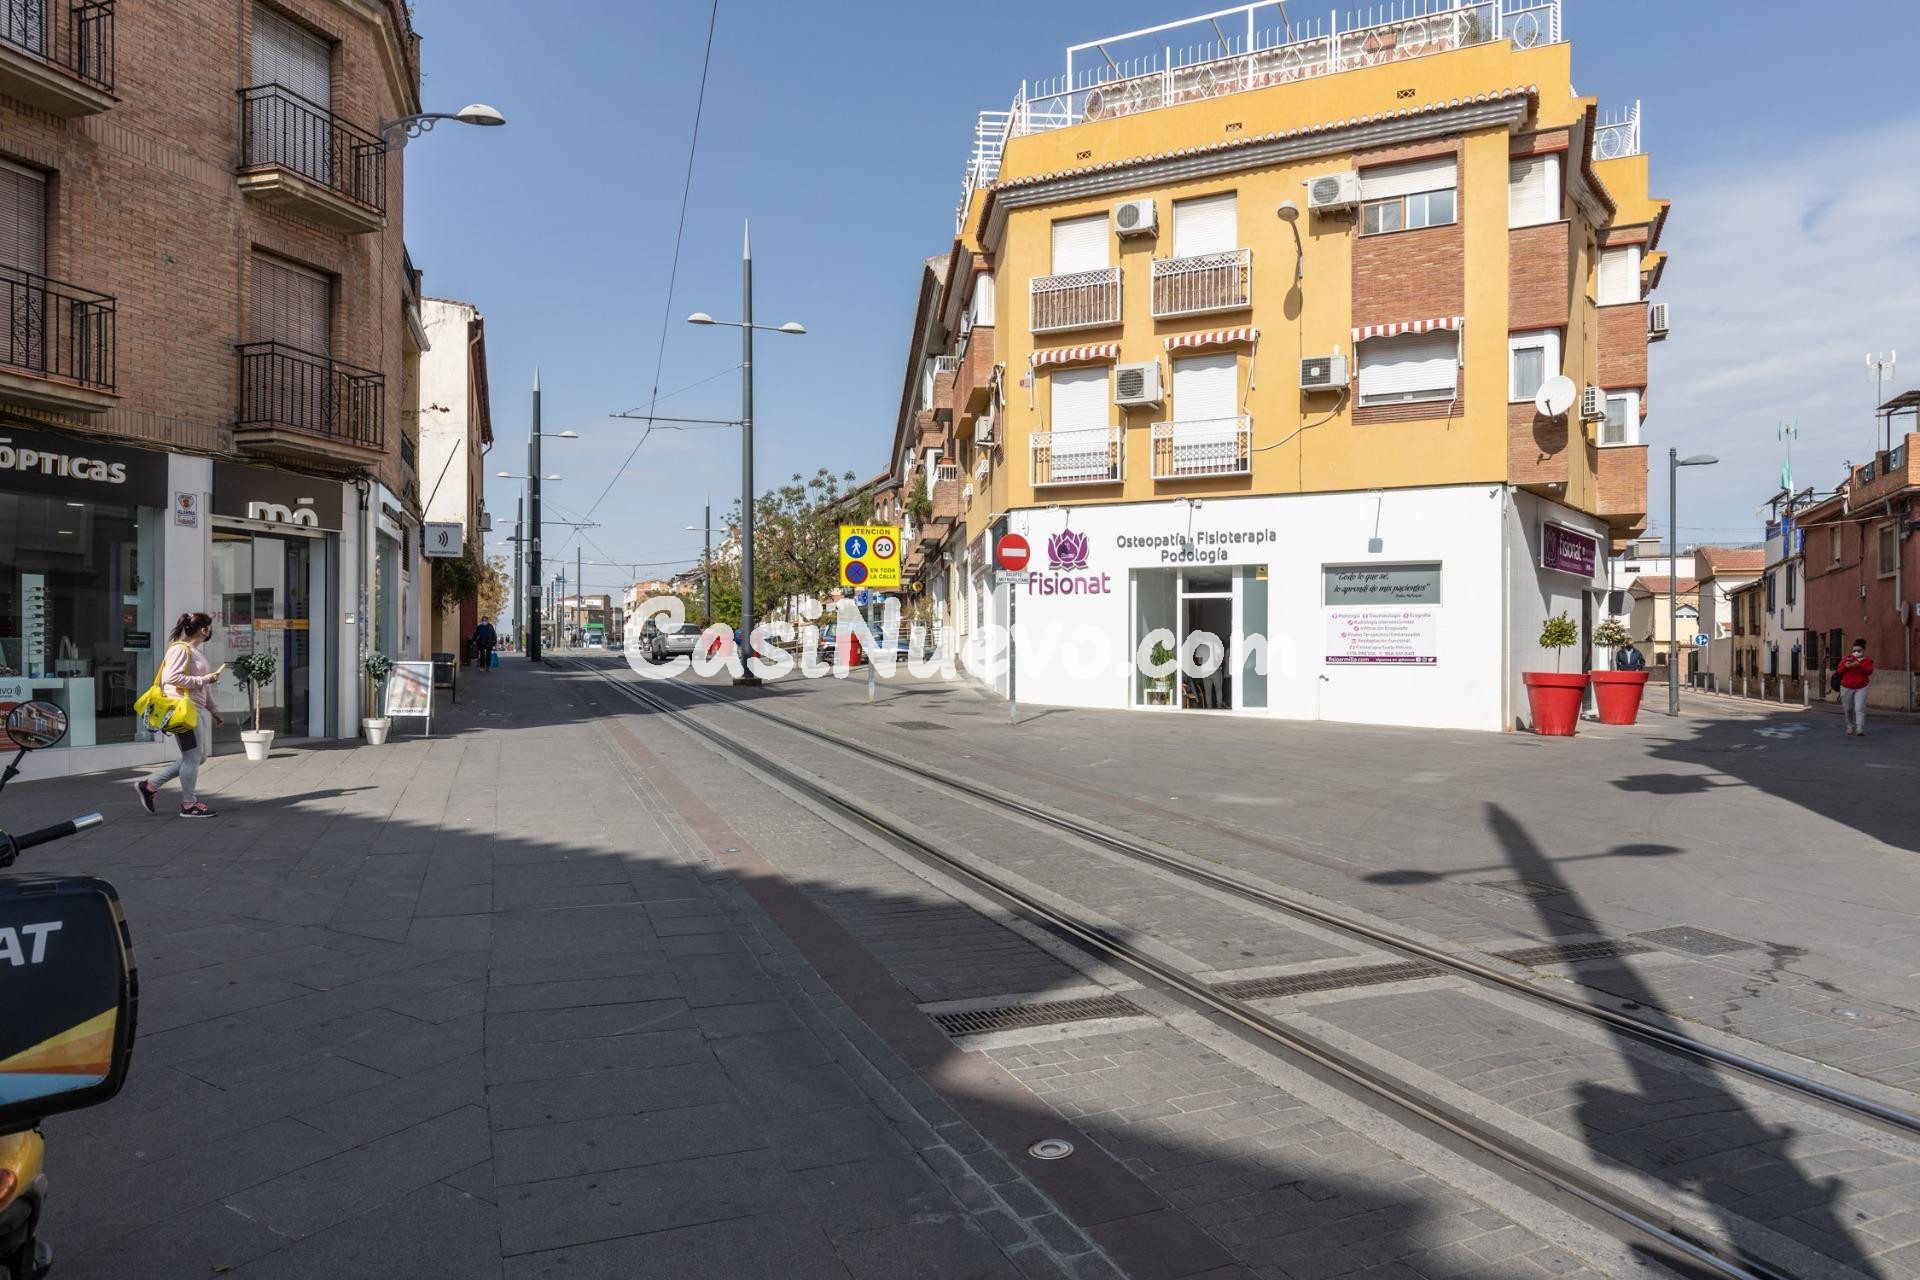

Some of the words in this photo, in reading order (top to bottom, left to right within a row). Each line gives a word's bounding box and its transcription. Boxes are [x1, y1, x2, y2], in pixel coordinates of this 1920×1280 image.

[1116, 533, 1186, 549] Osteopatía
[1197, 528, 1277, 545] Fisioterapia
[878, 543, 891, 552] 20
[1161, 547, 1228, 563] Podología
[1028, 571, 1111, 595] fisionat
[1365, 573, 1379, 583] que
[1368, 584, 1378, 592] de
[1378, 584, 1392, 592] mis
